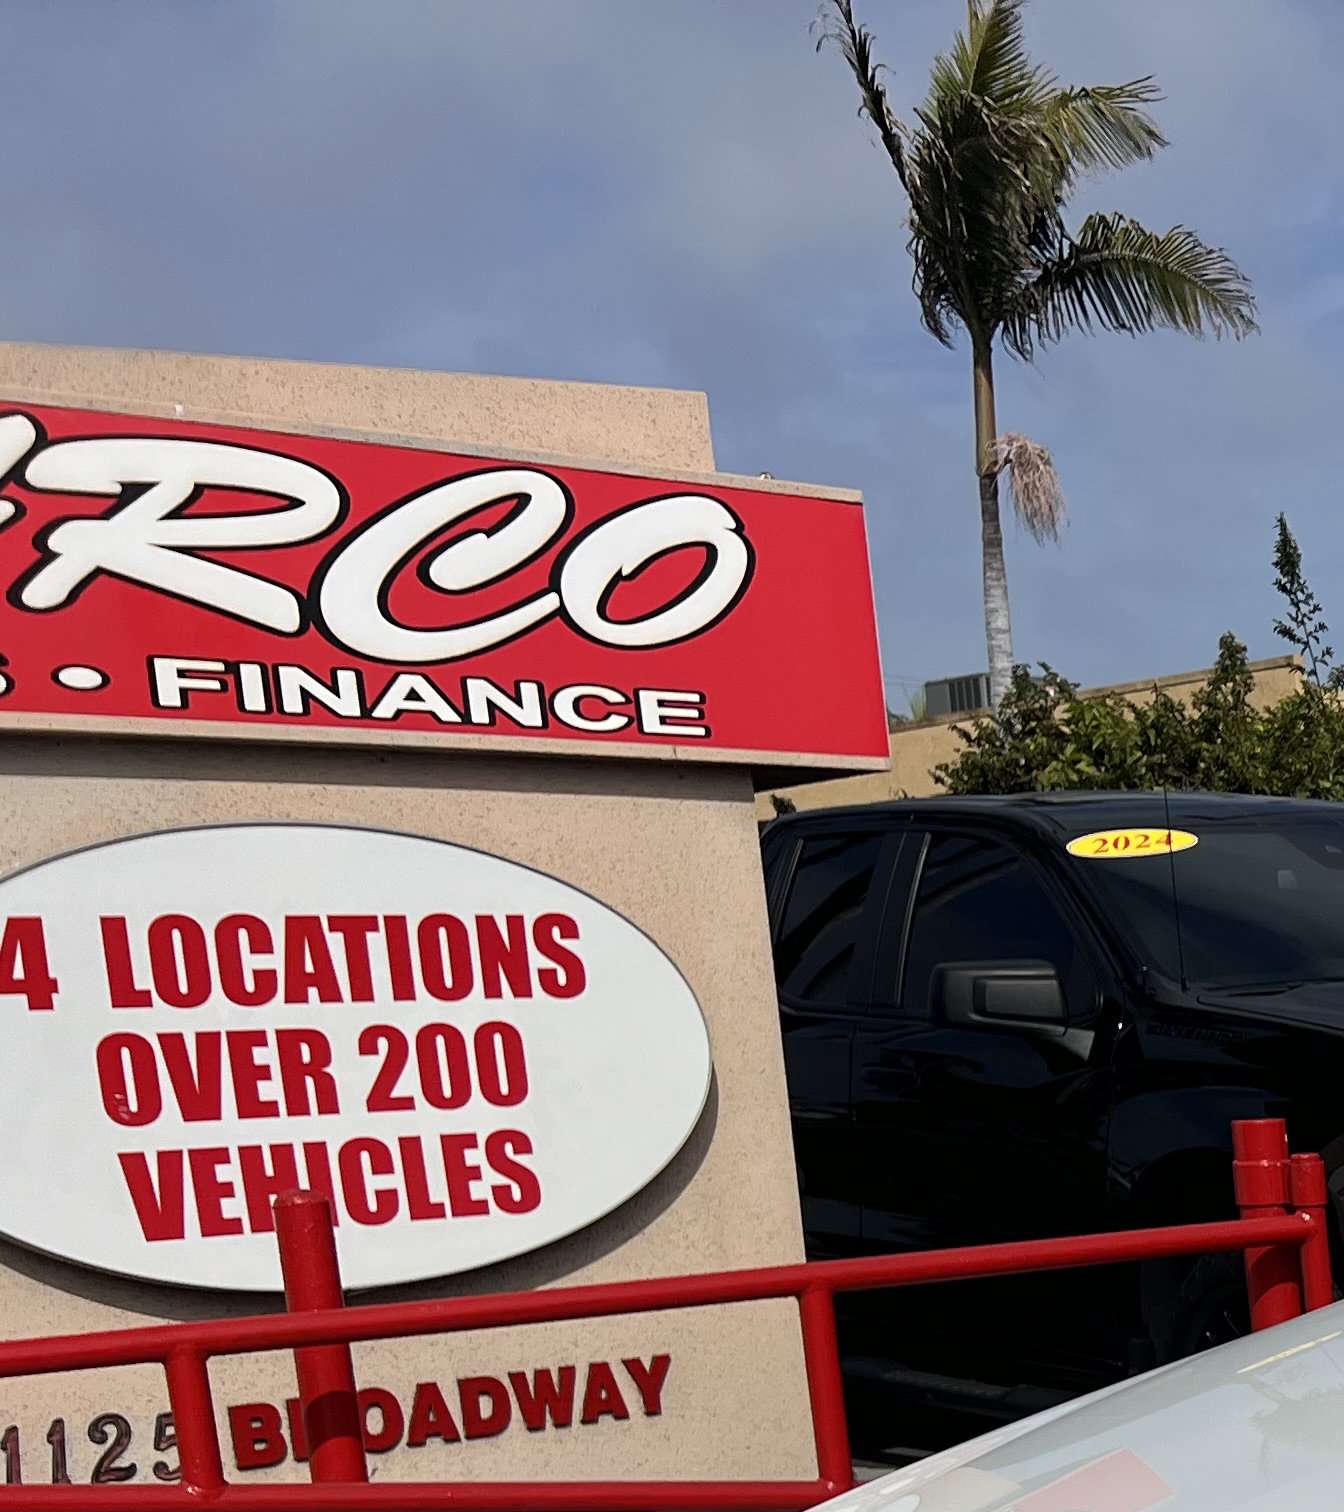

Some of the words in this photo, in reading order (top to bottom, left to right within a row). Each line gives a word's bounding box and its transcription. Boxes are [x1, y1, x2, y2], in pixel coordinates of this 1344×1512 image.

[151, 655, 711, 738] FINANCE
[1091, 833, 1173, 855] 2024
[0, 915, 59, 1012] 4
[99, 912, 588, 1010] LOCATIONS
[97, 1027, 340, 1128] OVER
[357, 1020, 530, 1113] 200
[118, 1128, 542, 1243] VEHICLES
[0, 1412, 185, 1484] 1125
